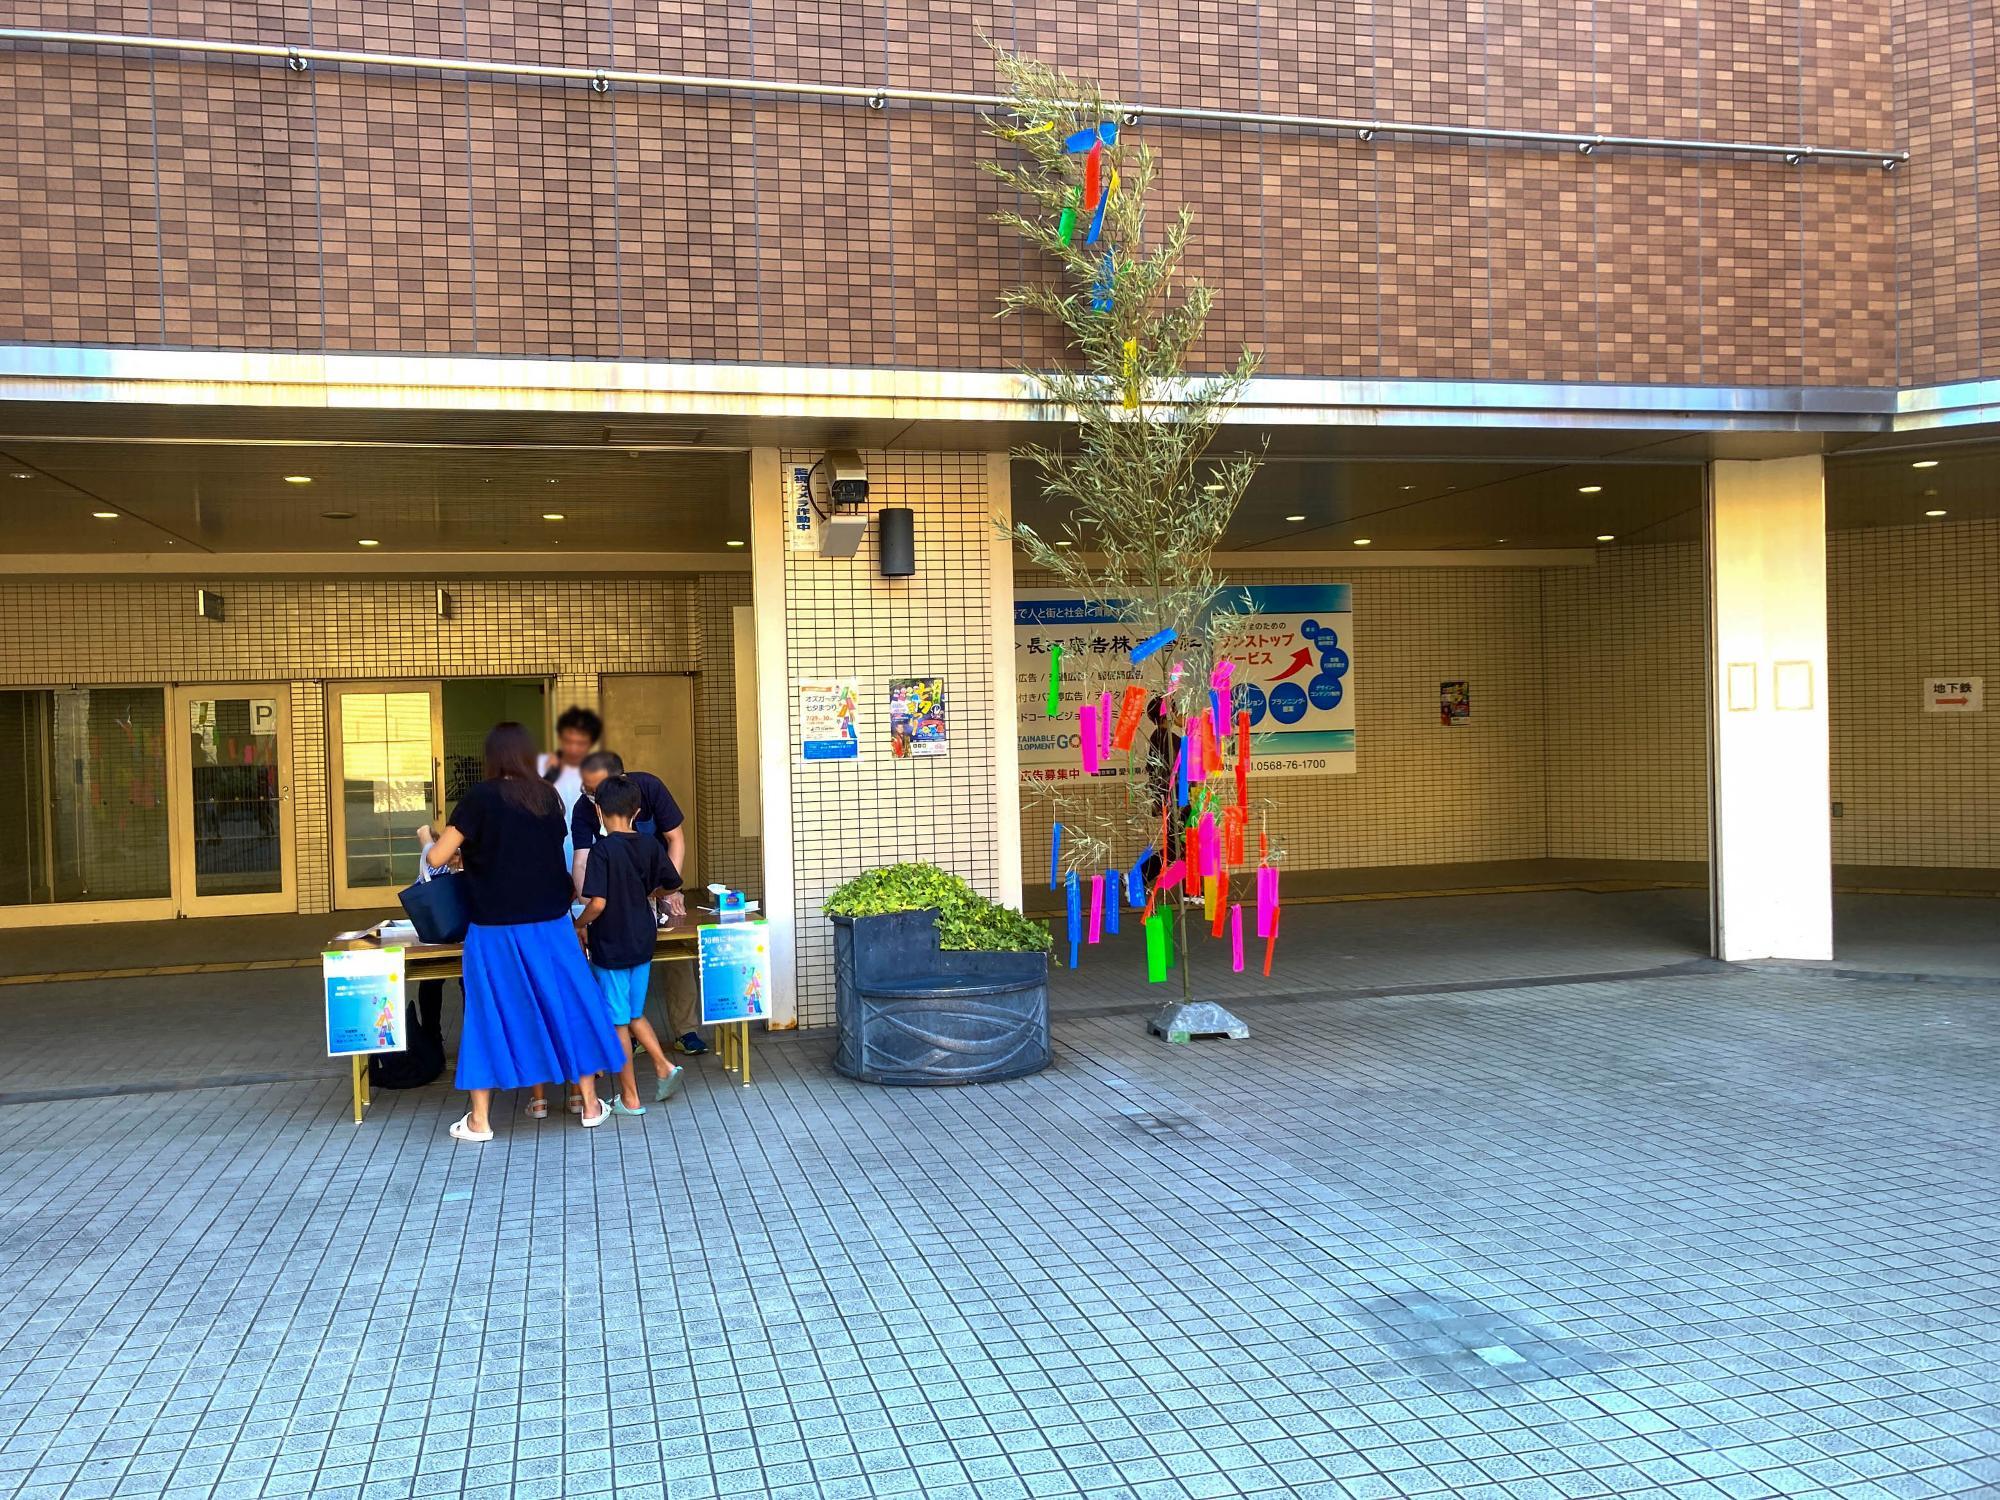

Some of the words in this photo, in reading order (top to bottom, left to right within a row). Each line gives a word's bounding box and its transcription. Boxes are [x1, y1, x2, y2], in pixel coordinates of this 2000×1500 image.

[1934, 682, 1972, 694] 地下鉄
[256, 705, 273, 725] P
[1250, 759, 1326, 772] l.0568-76-1700
